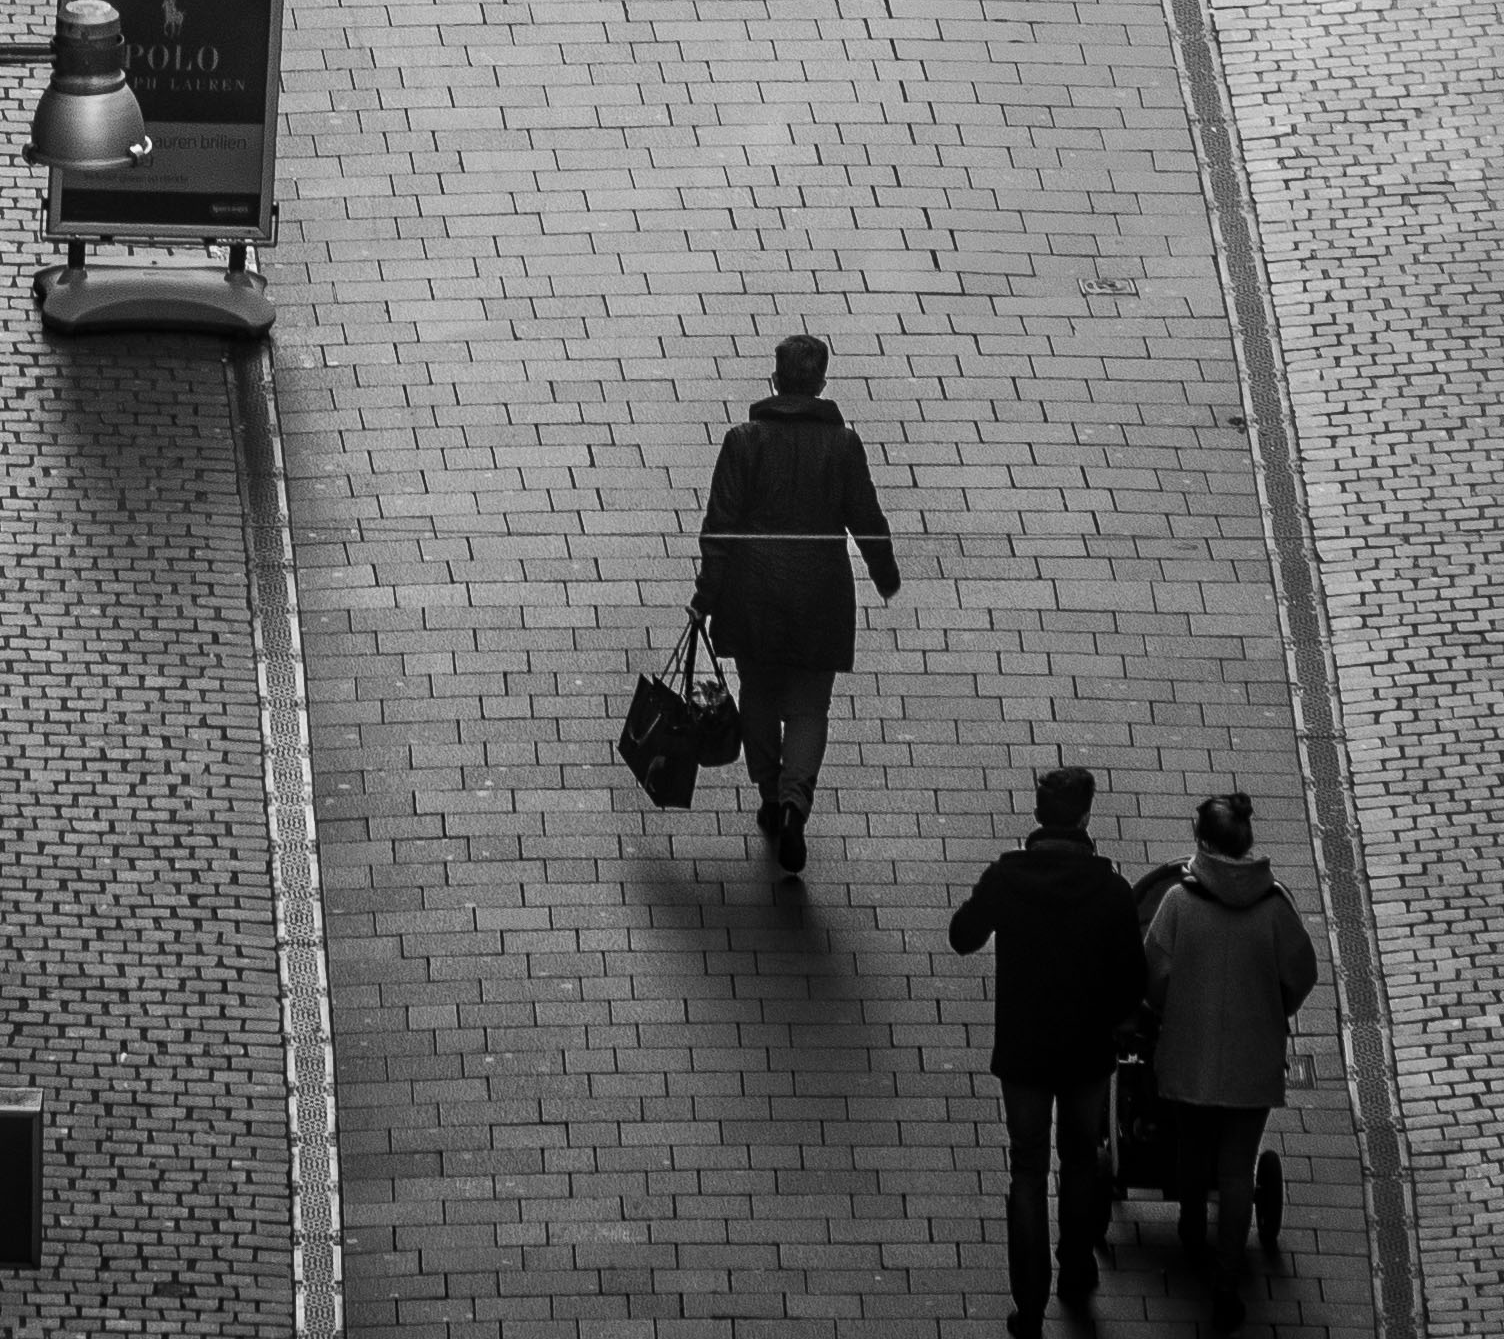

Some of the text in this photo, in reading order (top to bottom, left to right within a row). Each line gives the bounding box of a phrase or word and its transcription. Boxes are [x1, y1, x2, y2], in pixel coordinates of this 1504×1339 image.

[124, 44, 219, 71] POLO
[170, 77, 246, 92] LAUREN
[154, 136, 196, 150] auren
